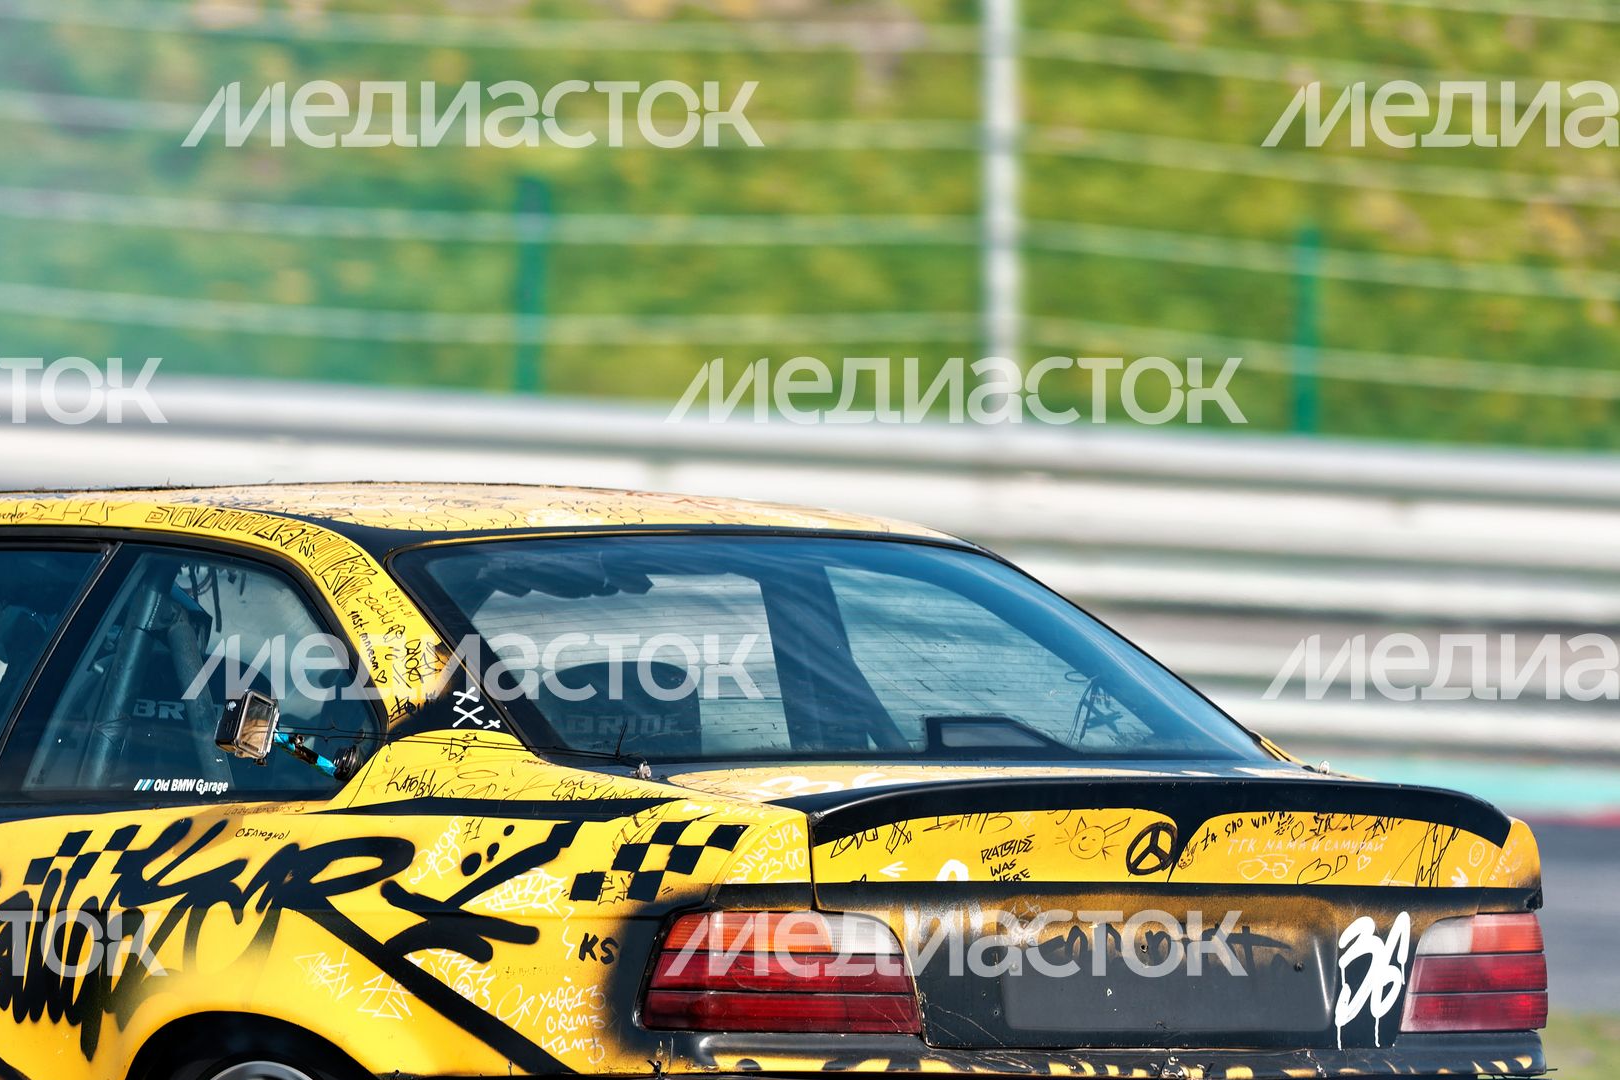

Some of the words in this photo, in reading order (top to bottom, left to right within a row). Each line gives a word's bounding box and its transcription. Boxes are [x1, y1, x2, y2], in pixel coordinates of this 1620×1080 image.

[153, 779, 171, 791] Old
[171, 779, 196, 791] BMW
[196, 779, 229, 795] Garage
[990, 858, 1017, 877] WAS
[578, 933, 618, 964] KS
